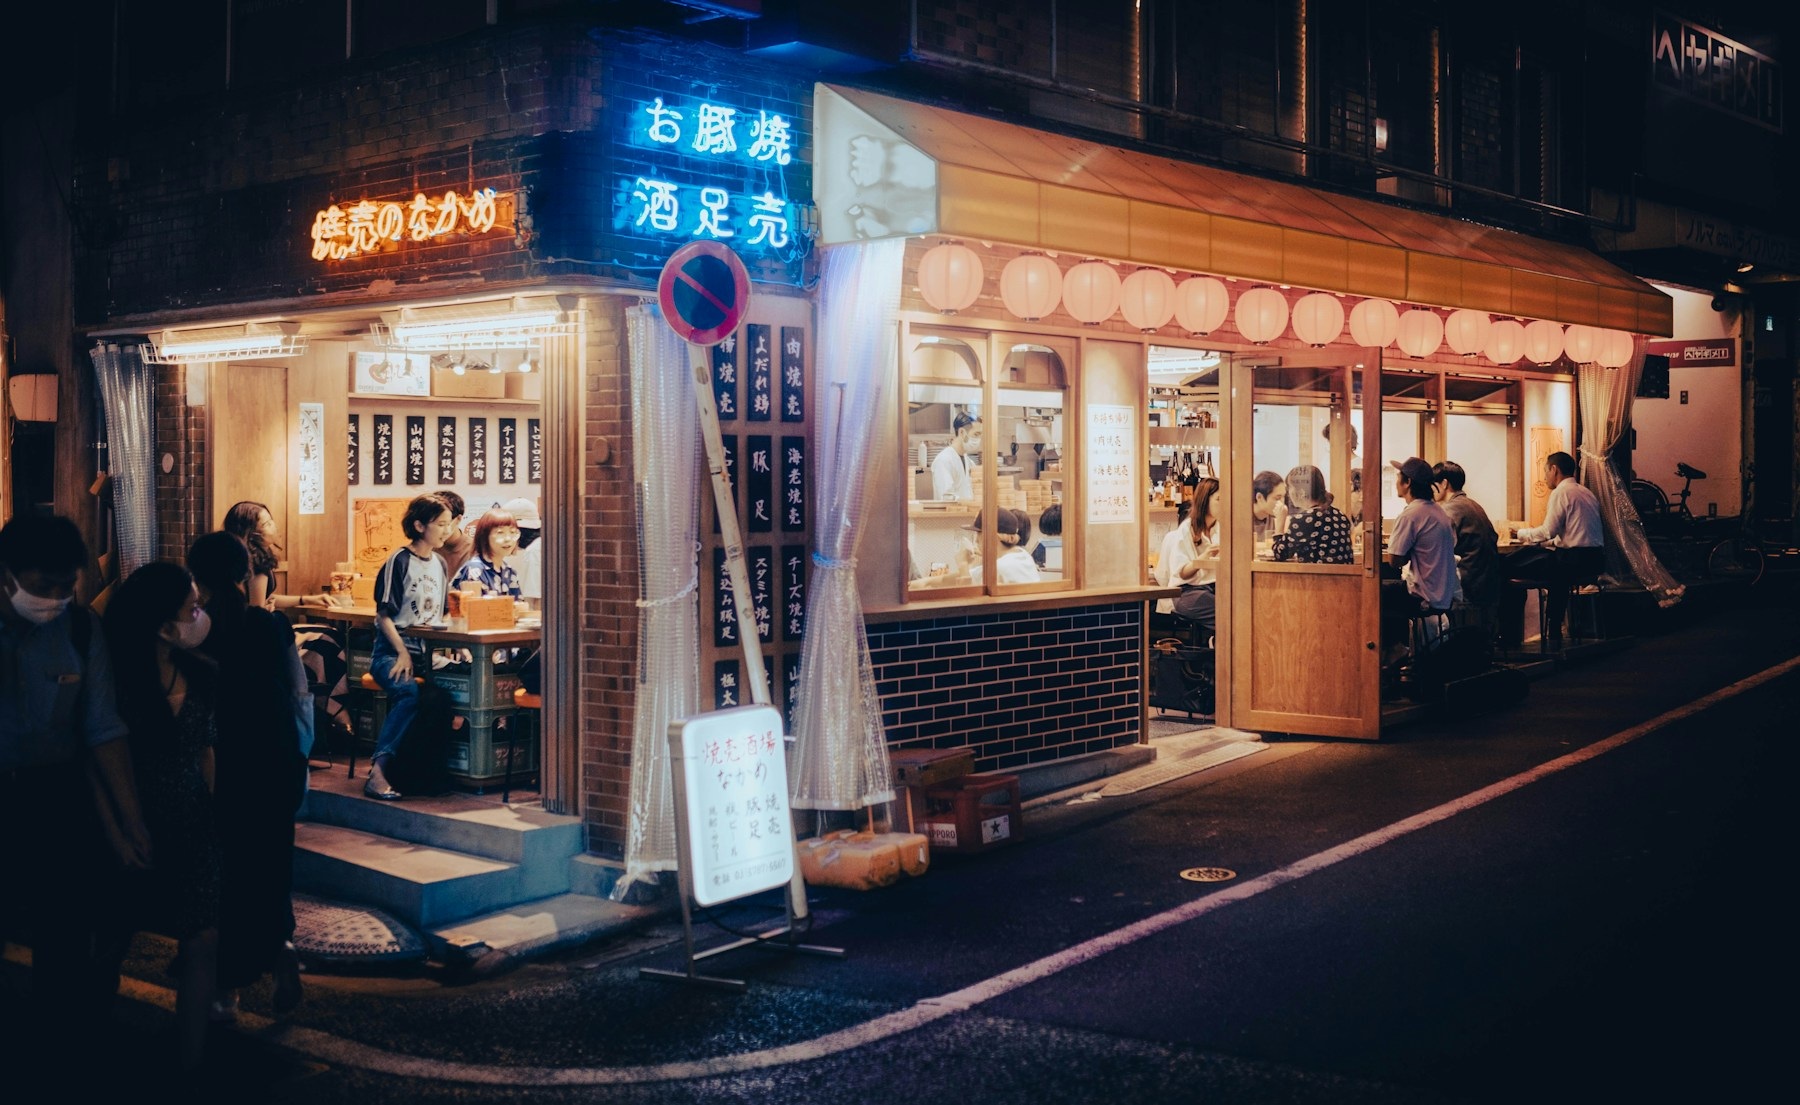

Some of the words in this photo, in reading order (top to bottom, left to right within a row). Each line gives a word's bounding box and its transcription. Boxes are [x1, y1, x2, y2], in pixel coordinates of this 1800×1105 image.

[754, 335, 770, 415] よだれ鶏
[786, 338, 802, 416] 肉焼売
[377, 422, 391, 480] 焼売メンチ
[409, 423, 424, 481] 山賊焼き
[441, 424, 455, 481] 煮込み豚足
[472, 425, 486, 480] スタミナ焼肉
[502, 425, 515, 480] チーズ焼売
[752, 450, 770, 521] 豚足
[788, 447, 803, 526] 海老焼売
[755, 557, 770, 637] スタミナ焼肉
[788, 556, 803, 635] チーズ焼売
[702, 730, 777, 767] 焼売酒場
[717, 761, 768, 790] なかめ
